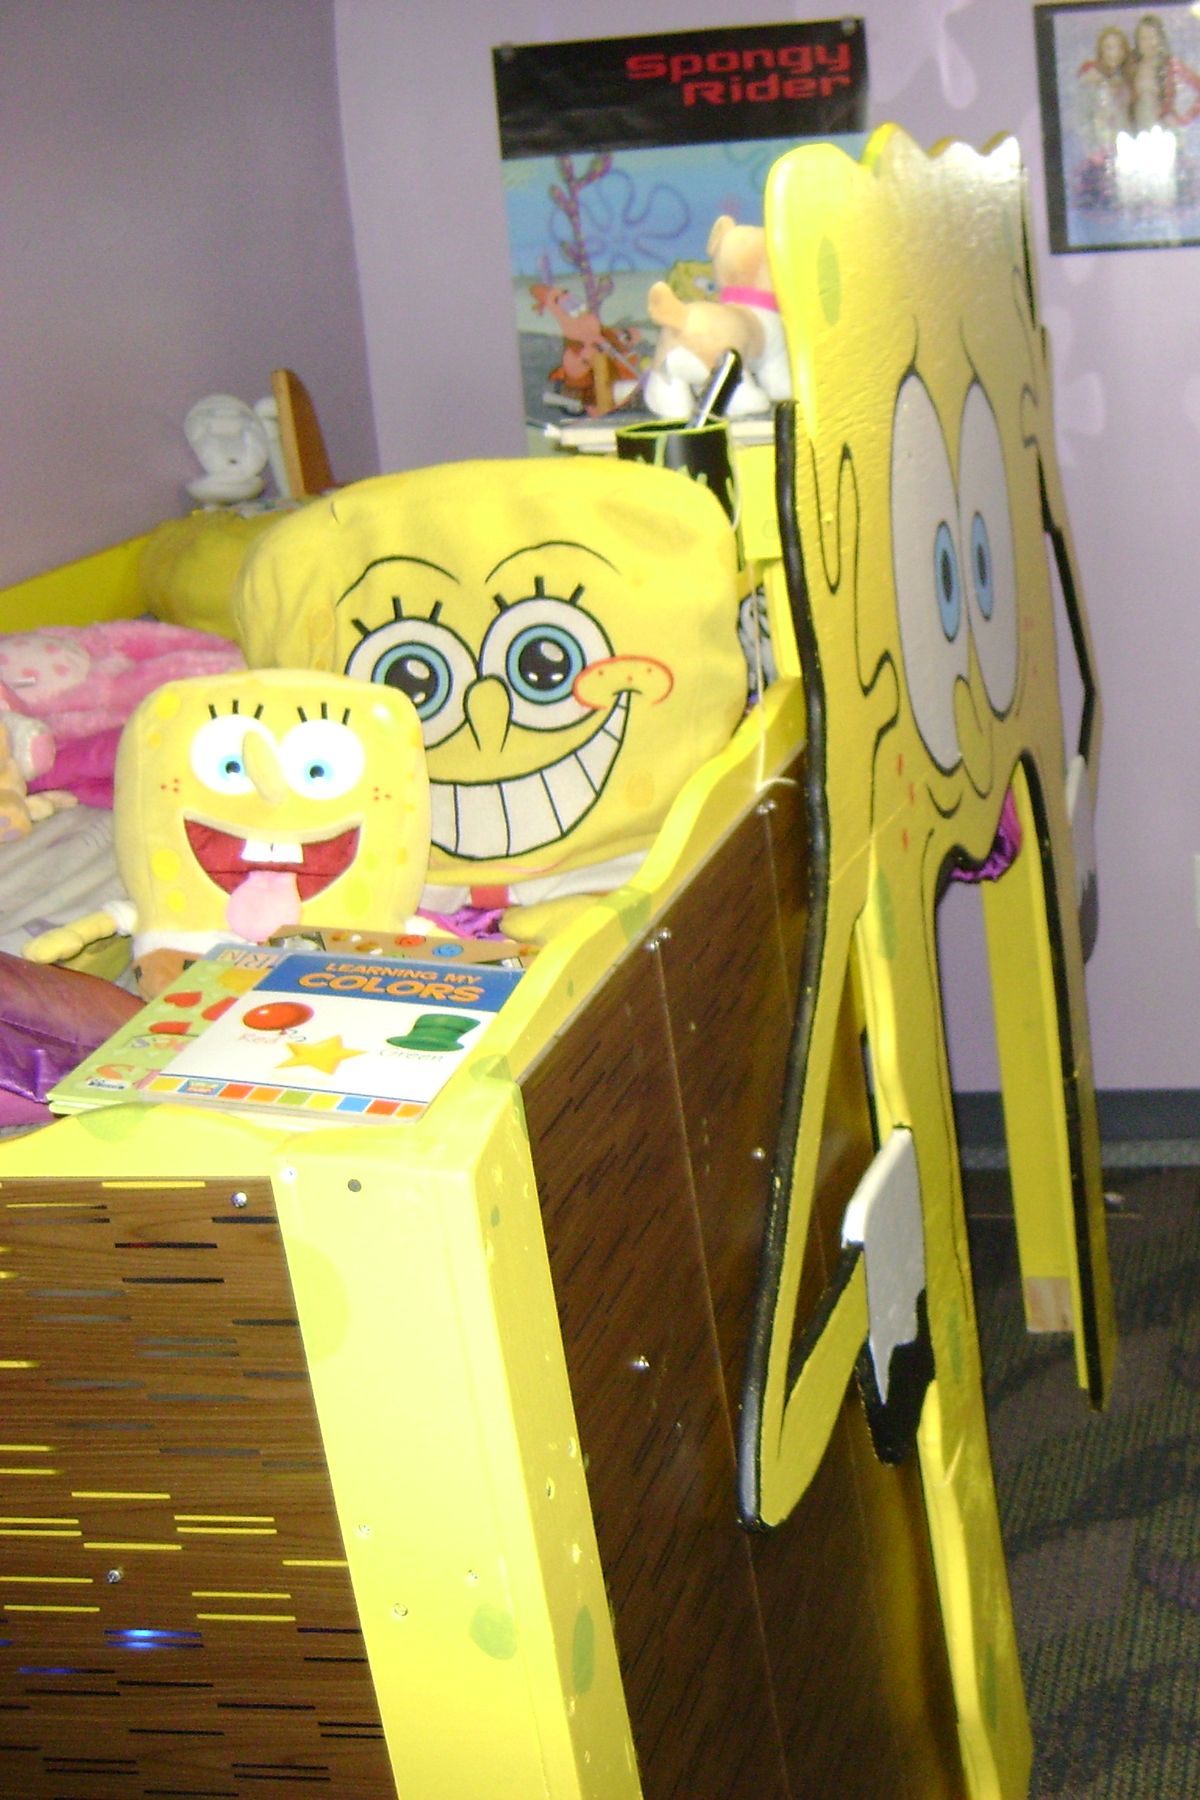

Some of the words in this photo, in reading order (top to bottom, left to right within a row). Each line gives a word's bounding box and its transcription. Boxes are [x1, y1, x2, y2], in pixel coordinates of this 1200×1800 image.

[625, 42, 851, 83] Spongy
[682, 73, 851, 108] Rider
[298, 972, 486, 1004] COLORS
[325, 962, 438, 982] LEARNING
[443, 972, 483, 985] MY
